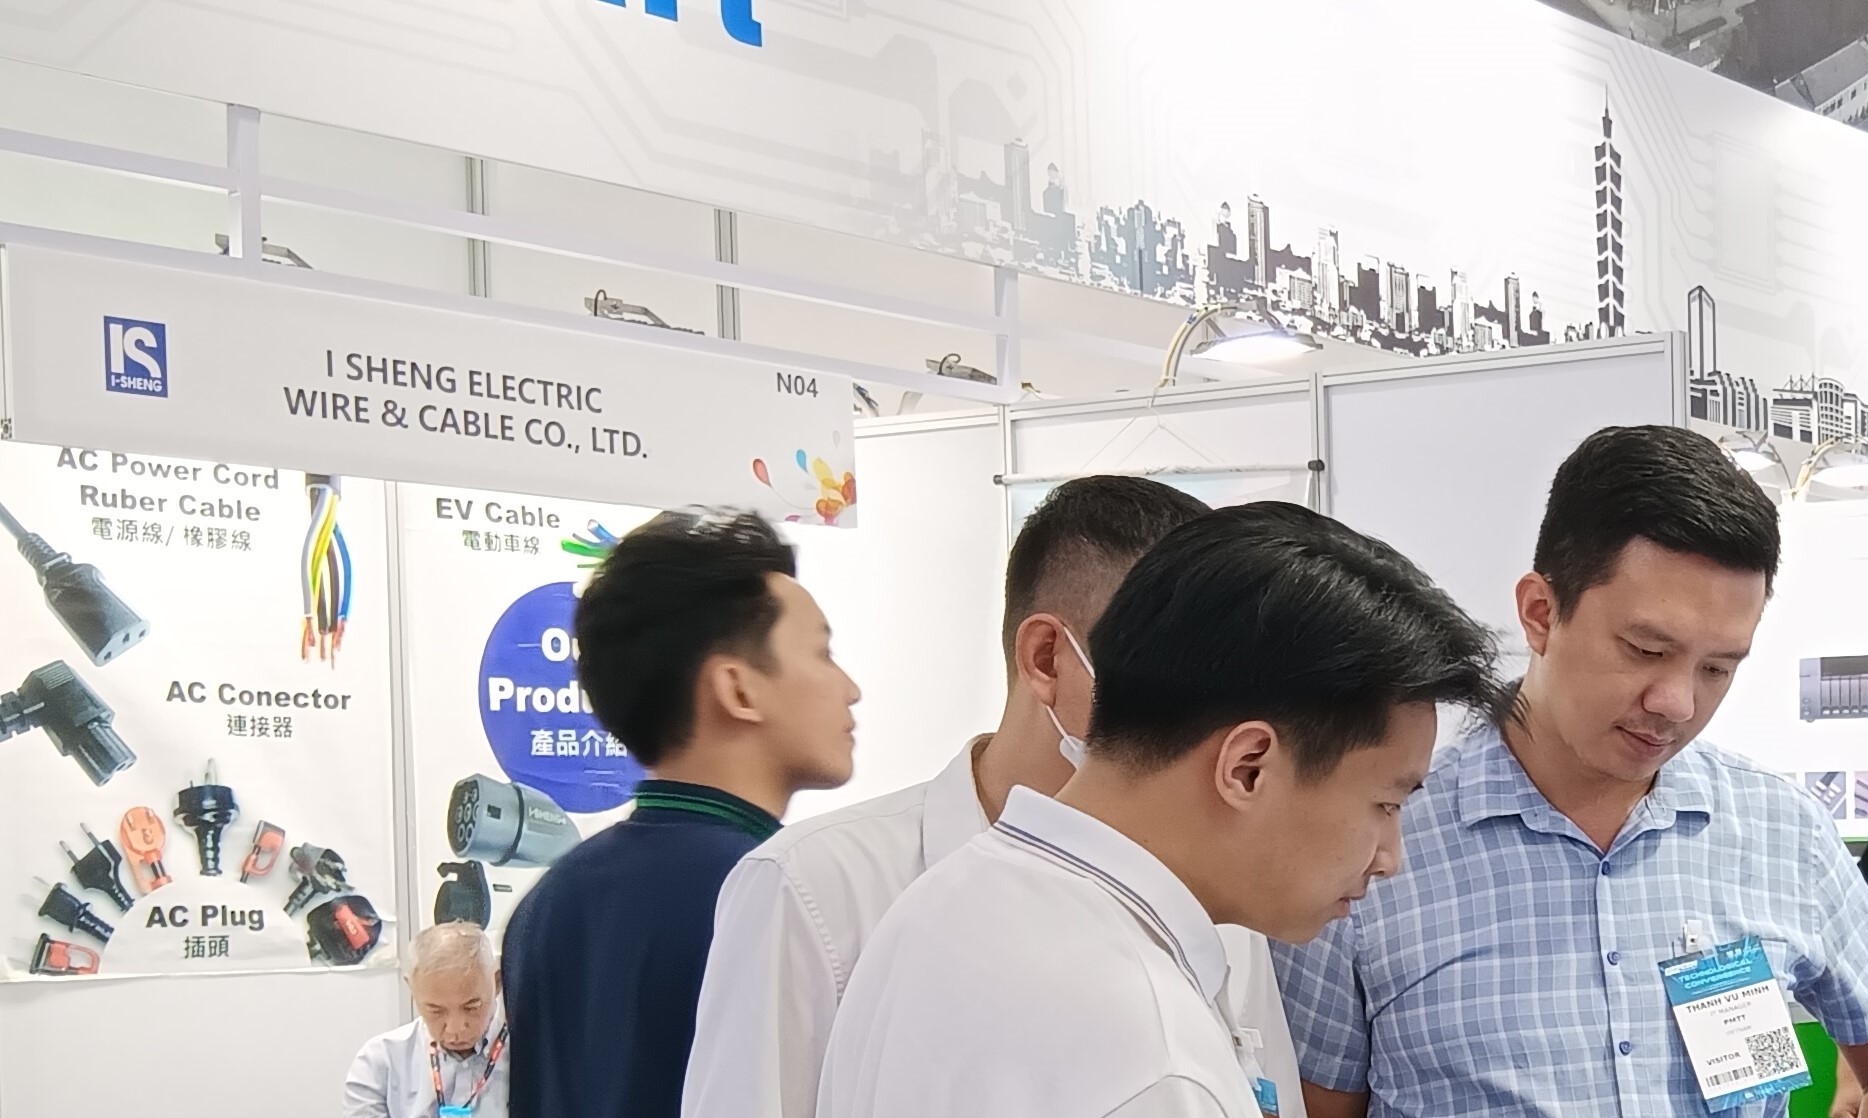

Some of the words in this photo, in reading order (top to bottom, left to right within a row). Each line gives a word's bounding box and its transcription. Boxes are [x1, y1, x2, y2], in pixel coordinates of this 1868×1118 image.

[111, 374, 162, 392] I-SHENG
[325, 349, 334, 377] I
[345, 351, 458, 395] SHENG
[468, 367, 604, 415] ELECTRIC
[776, 371, 820, 400] N04
[283, 385, 371, 427] WIRE
[380, 396, 409, 429] &
[419, 401, 516, 445] CABLE
[525, 415, 583, 455] CO.,
[592, 425, 649, 459] LTD.
[57, 447, 99, 473] AC
[111, 451, 202, 484] Power
[213, 463, 279, 490] Cord
[80, 484, 168, 514] Ruber
[179, 494, 261, 522] Cable
[435, 497, 474, 522] EV
[485, 501, 561, 529] Cable
[167, 681, 207, 705] AC
[218, 683, 352, 710] Conector
[227, 713, 293, 739] 連接器
[146, 906, 189, 928] AC
[201, 905, 265, 931] Plug
[184, 934, 230, 959] 插頭
[1686, 997, 1722, 1014] THANH
[1741, 985, 1770, 998] MINH
[1706, 1051, 1741, 1066] VISITOR
